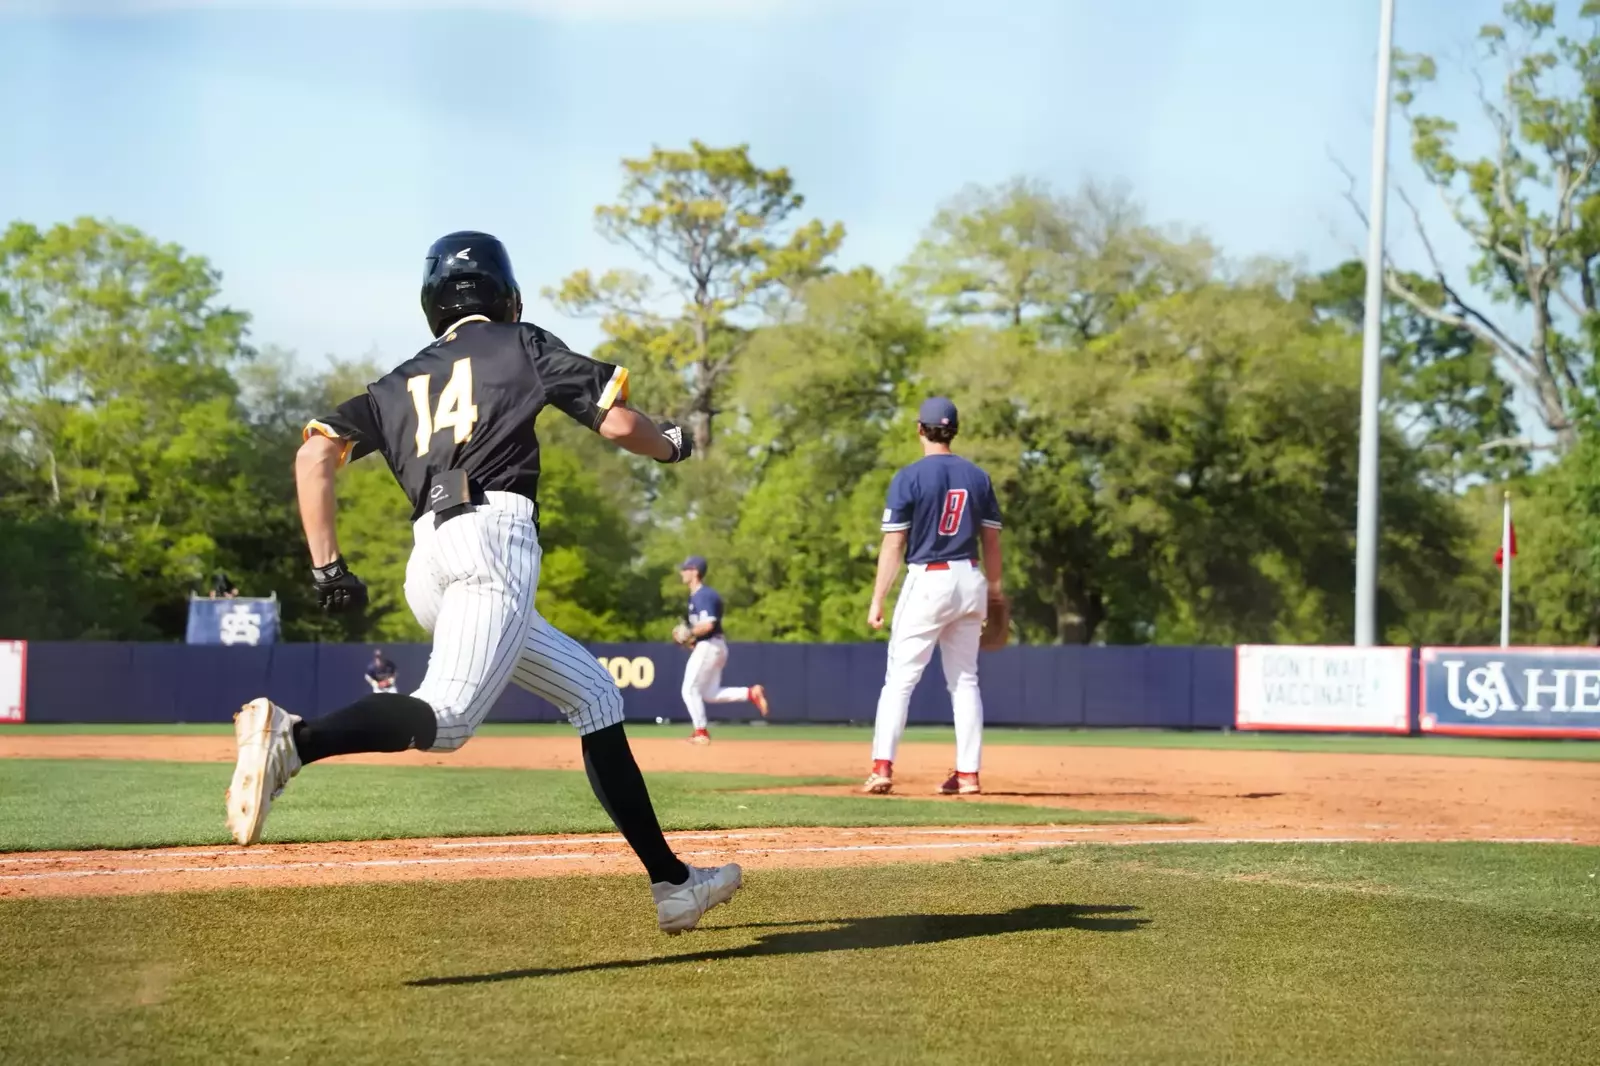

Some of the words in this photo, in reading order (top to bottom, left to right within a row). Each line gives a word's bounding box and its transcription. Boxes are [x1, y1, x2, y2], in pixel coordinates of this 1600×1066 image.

[407, 357, 478, 457] 14
[938, 489, 968, 536] 8
[1262, 655, 1316, 678] DONT
[1263, 683, 1367, 707] VACCINATE
